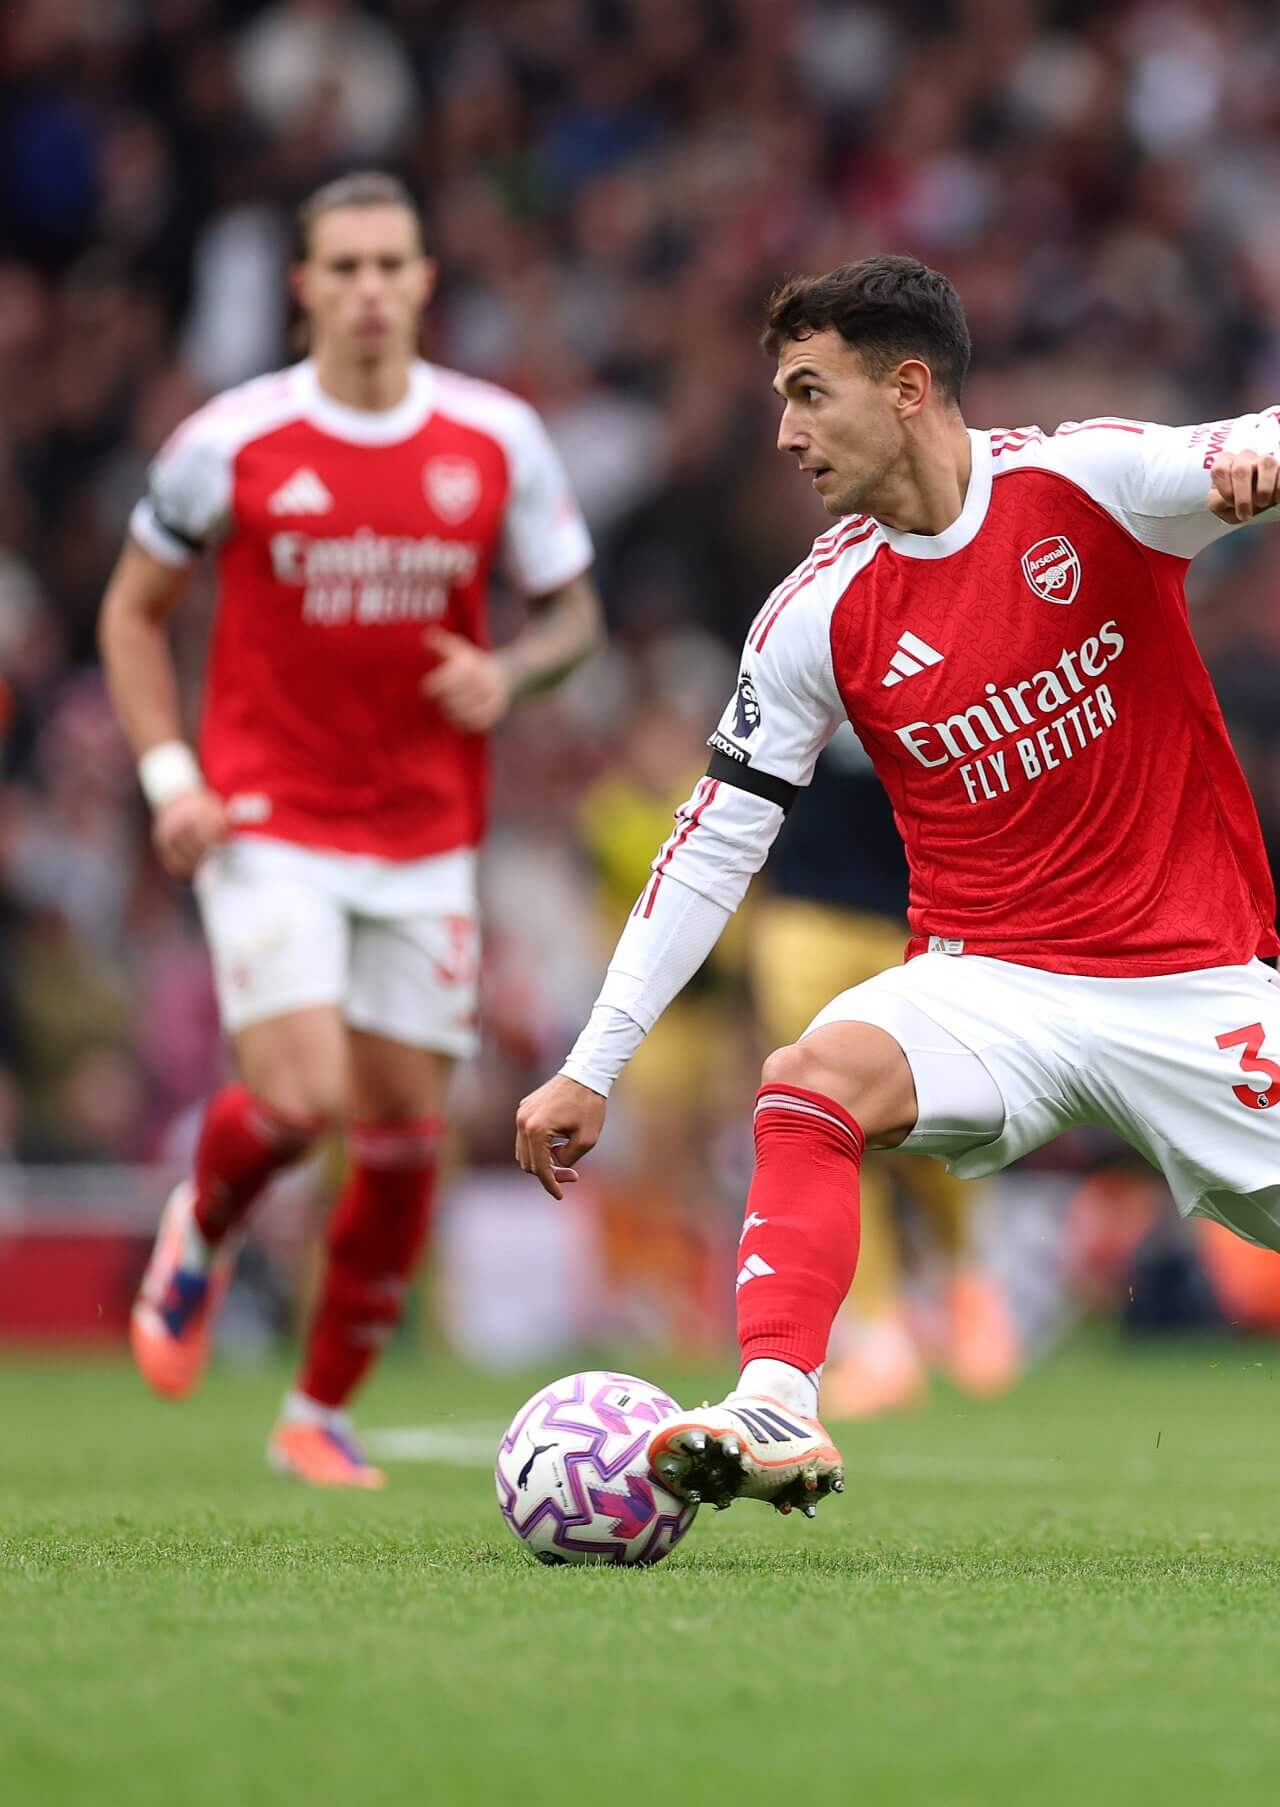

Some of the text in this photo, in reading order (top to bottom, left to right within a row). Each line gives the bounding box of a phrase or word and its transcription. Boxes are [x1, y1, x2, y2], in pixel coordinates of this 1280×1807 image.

[1030, 545, 1067, 572] Arsenal
[894, 620, 1125, 768] Emirates
[959, 683, 1118, 803] FLY BETTER
